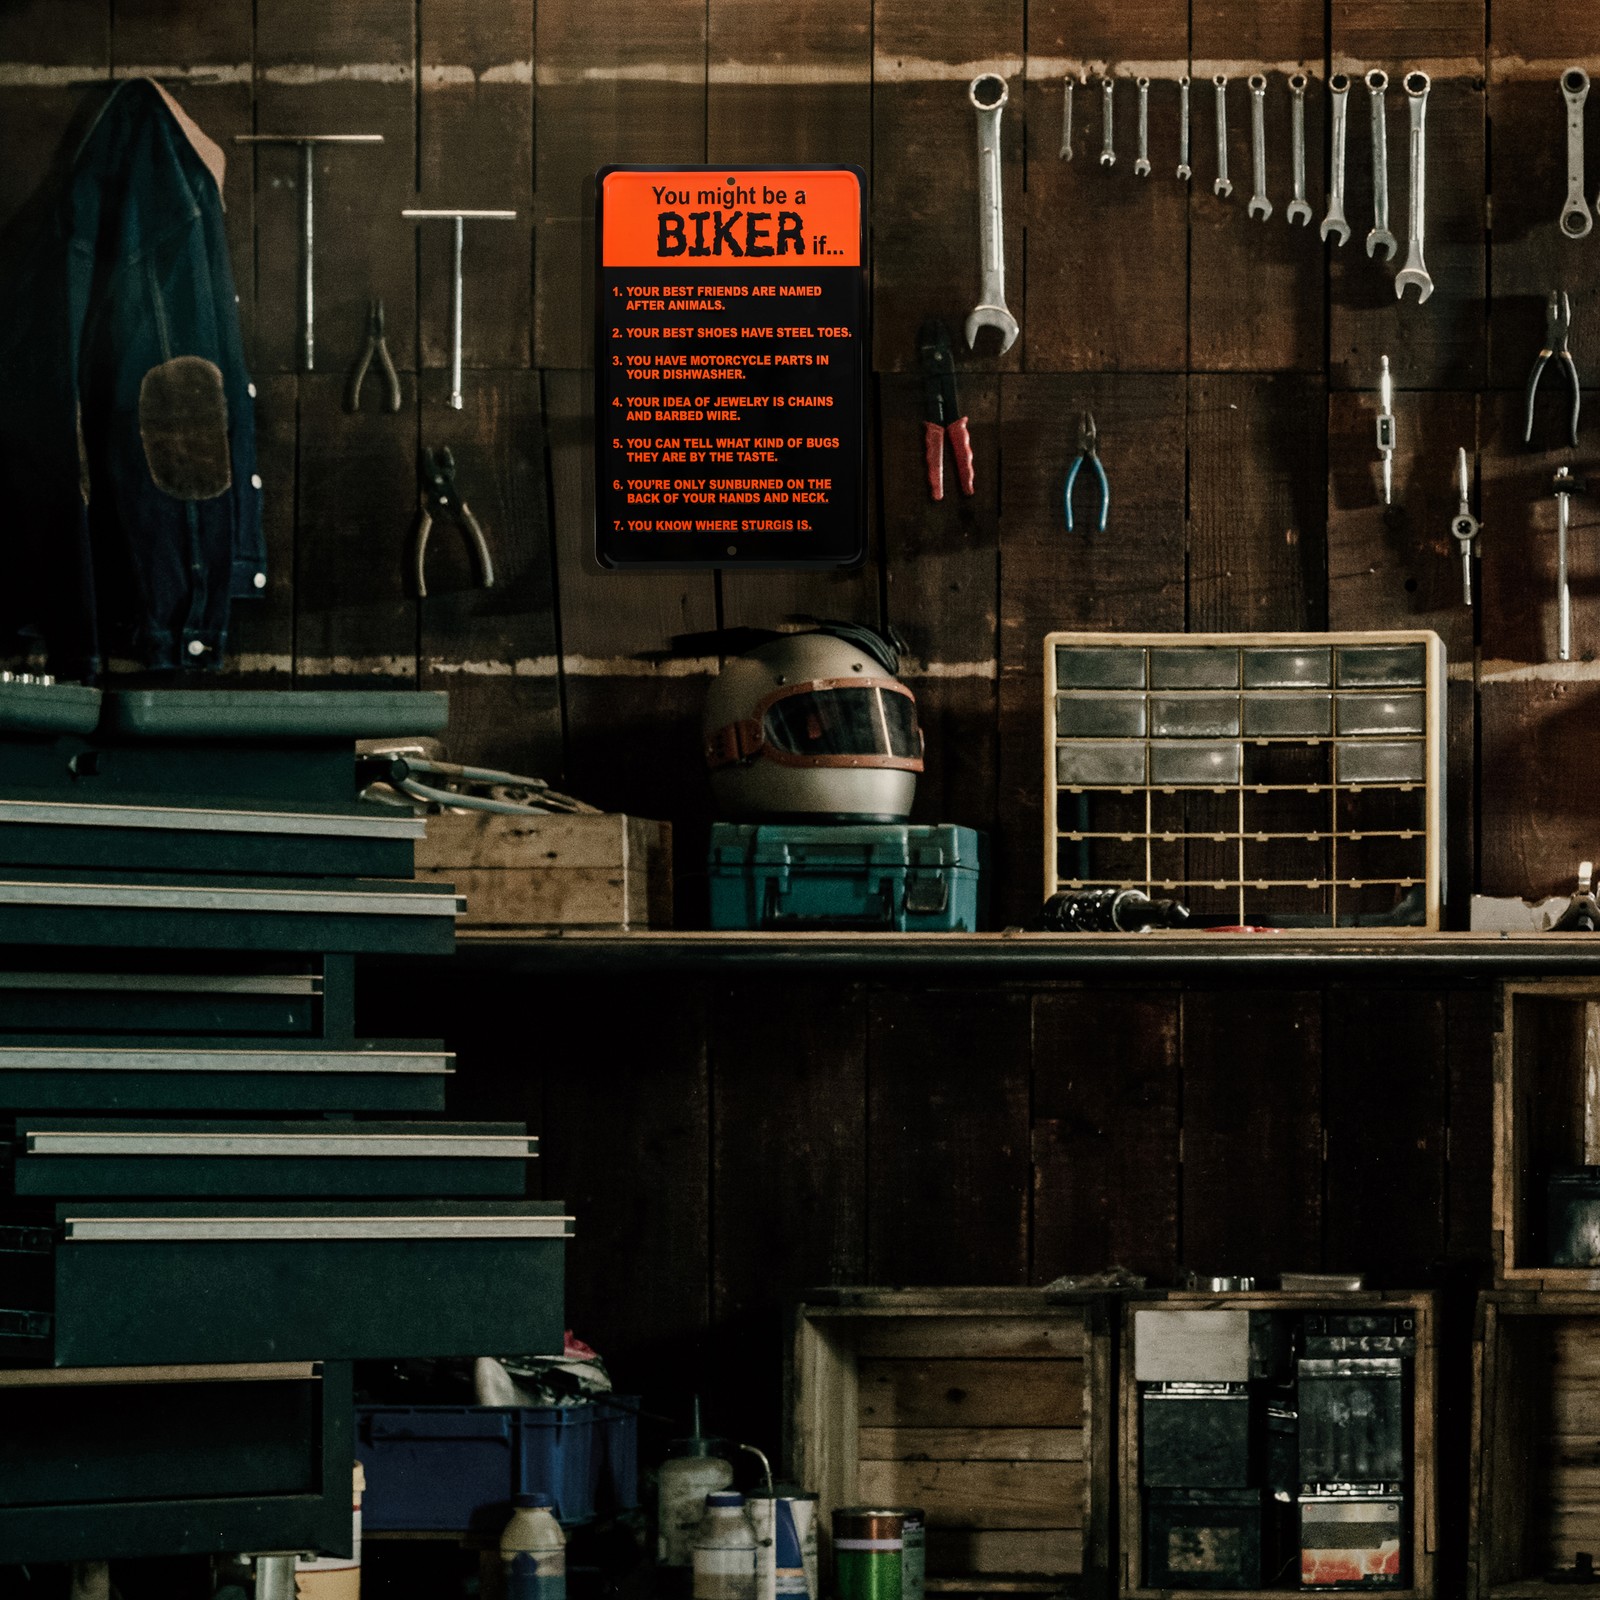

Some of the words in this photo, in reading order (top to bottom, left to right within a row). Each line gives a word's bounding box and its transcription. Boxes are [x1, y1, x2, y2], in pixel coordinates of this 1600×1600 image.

[652, 186, 690, 205] You
[697, 186, 756, 210] might
[763, 185, 787, 205] be
[794, 190, 806, 205] a
[656, 210, 806, 258] BIKER
[813, 235, 844, 255] if...
[612, 286, 623, 297] 1.
[626, 286, 660, 297] YOUR
[662, 285, 695, 297] BEST
[697, 285, 749, 297] FRIENDS
[751, 285, 777, 297] ARE
[779, 285, 823, 297] NAMED
[625, 299, 665, 311] AFTER
[667, 299, 726, 311] ANIMALS.
[611, 327, 623, 339] 2.
[625, 327, 660, 339] YOUR
[662, 327, 695, 339] BEST
[697, 327, 738, 339] SHOES
[741, 327, 774, 338] HAVE
[776, 327, 815, 338] STEEL
[816, 326, 852, 338] TOES.
[612, 355, 623, 366] 3.
[625, 355, 652, 366] YOU
[654, 355, 687, 366] HAVE
[690, 355, 772, 366] MOTORCYCLE
[774, 354, 813, 366] PARTS
[816, 354, 829, 366] IN
[626, 368, 660, 380] YOUR
[662, 368, 746, 380] DISHWASHER.
[611, 396, 623, 408] 4.
[626, 396, 661, 408] YOUR
[663, 396, 692, 408] IDEA
[694, 396, 711, 408] OF
[713, 396, 770, 408] JEWELRY
[772, 396, 785, 407] IS
[787, 395, 834, 407] CHAINS
[626, 410, 652, 421] AND
[655, 410, 704, 421] BARBED
[706, 410, 741, 421] WIRE.
[612, 438, 624, 449] 5.
[626, 437, 652, 449] YOU
[654, 437, 681, 449] CAN
[683, 437, 714, 449] TELL
[715, 437, 751, 449] WHAT
[753, 437, 784, 449] KIND
[786, 437, 803, 449] OF
[806, 437, 840, 449] BUGS
[626, 451, 659, 463] THEY
[661, 451, 687, 463] ARE
[689, 451, 707, 463] BY
[708, 451, 734, 463] THE
[736, 451, 778, 463] TASTE.
[612, 479, 624, 490] 6.
[626, 479, 671, 491] YOU'RE
[673, 479, 706, 490] ONLY
[709, 478, 784, 490] SUNBURNED
[786, 478, 805, 490] ON
[807, 478, 832, 490] THE
[627, 492, 661, 504] BACK
[663, 492, 680, 504] OF
[682, 492, 716, 504] YOUR
[718, 492, 761, 504] HANDS
[763, 492, 790, 503] AND
[792, 492, 829, 503] NECK.
[613, 520, 624, 531] 7.
[627, 520, 653, 531] YOU
[655, 520, 693, 531] KNOW
[695, 519, 738, 531] WHERE
[741, 519, 794, 531] STURGIS
[796, 519, 812, 531] IS.
